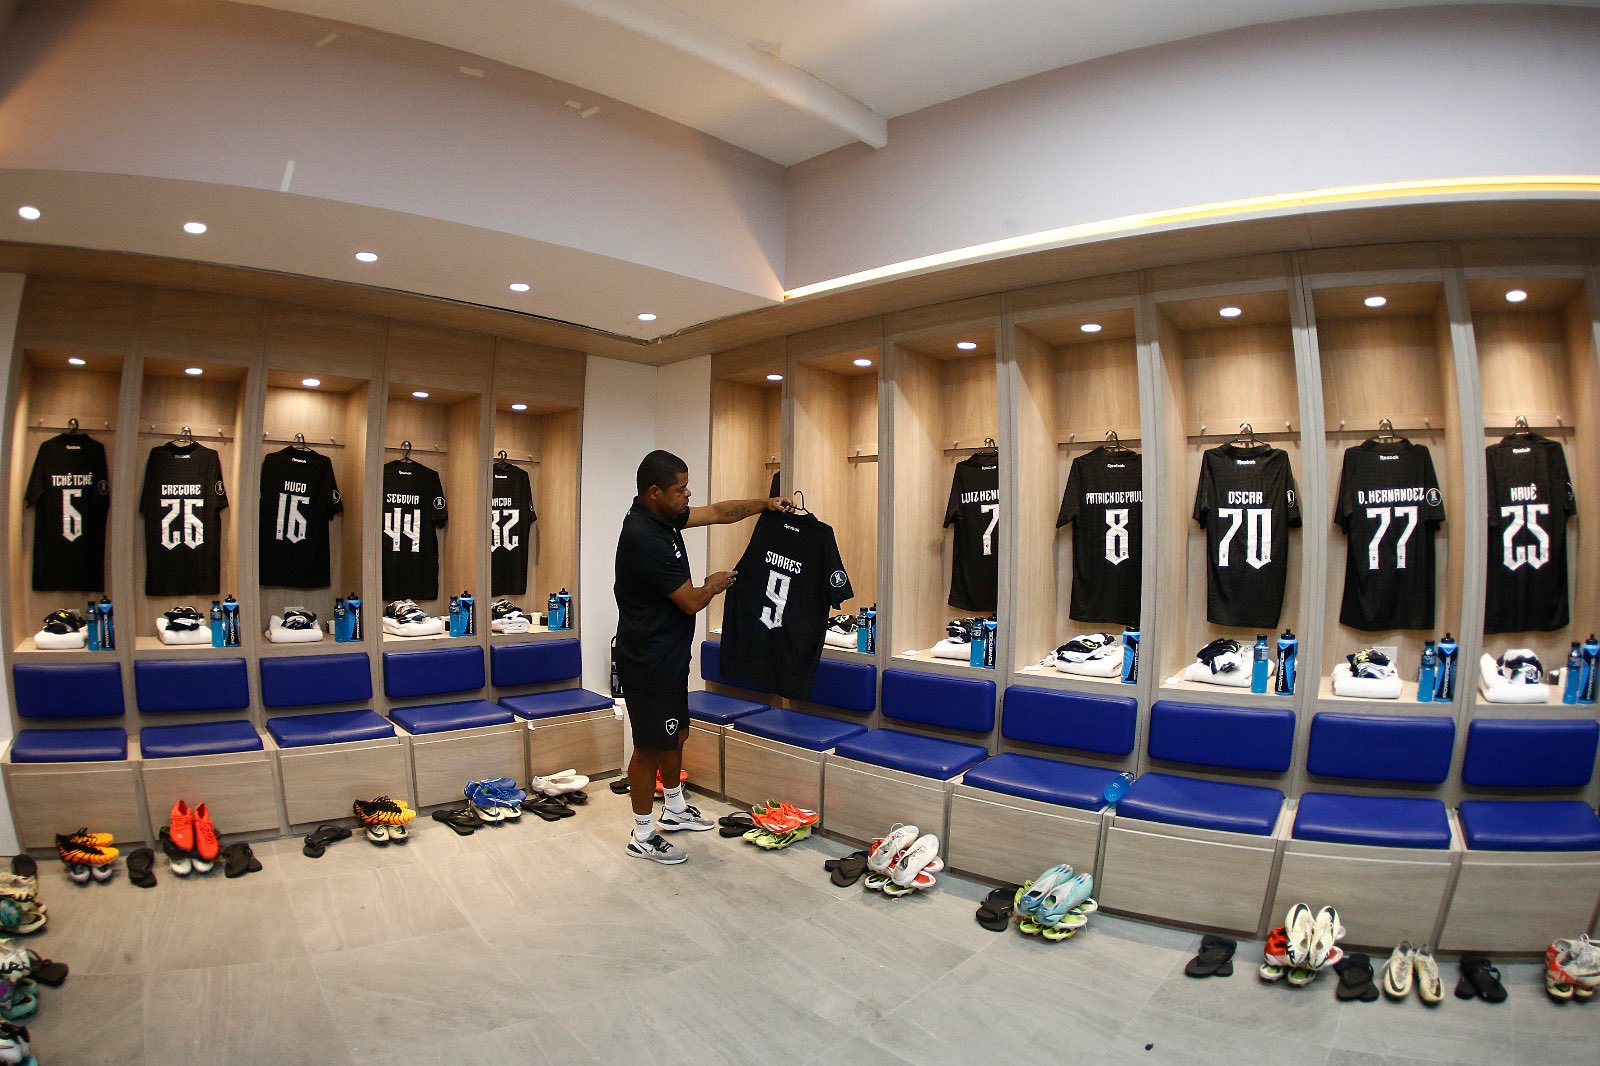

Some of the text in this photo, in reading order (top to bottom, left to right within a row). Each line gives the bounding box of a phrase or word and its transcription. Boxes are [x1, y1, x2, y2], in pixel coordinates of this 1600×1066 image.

[51, 471, 93, 487] TCHÊ TCHÊ
[161, 484, 201, 496] GREGORE
[284, 480, 307, 493] HUGO
[1358, 487, 1424, 505] D. HERNANDEZ
[1510, 483, 1537, 502] KAUÊ
[62, 488, 82, 542] 6
[386, 493, 419, 505] SEGOVIA
[961, 491, 979, 504] LUIZ
[1085, 491, 1114, 505] PATRICK
[1115, 491, 1125, 504] DE
[1228, 490, 1263, 505] OSCAR
[160, 498, 204, 550] 26
[275, 492, 310, 544] 16
[383, 507, 421, 553] 44
[980, 504, 999, 556] 7
[1104, 508, 1129, 566] 8
[1218, 508, 1272, 570] 70
[1366, 505, 1418, 570] 77
[1500, 503, 1550, 571] 25
[765, 550, 802, 574] SOARES
[759, 569, 792, 629] 9
